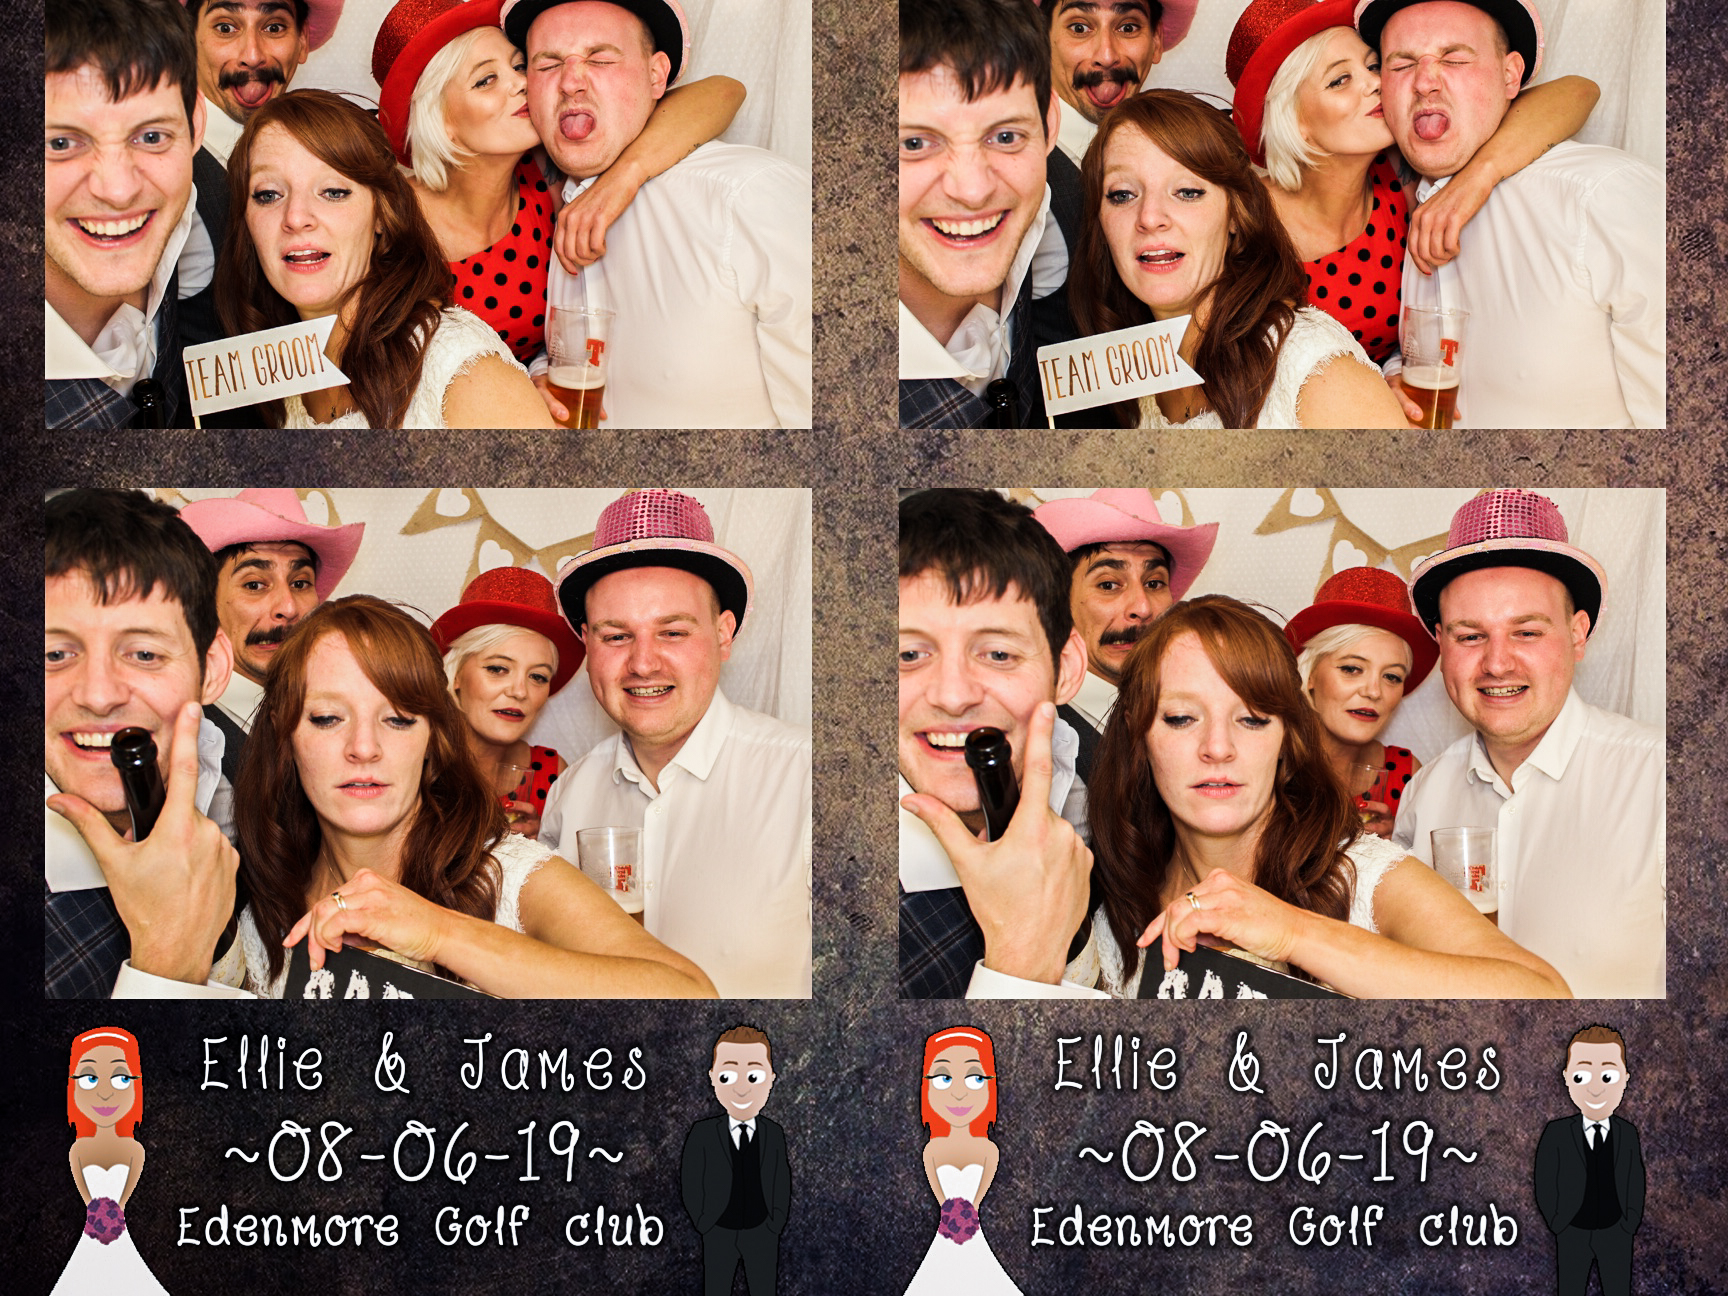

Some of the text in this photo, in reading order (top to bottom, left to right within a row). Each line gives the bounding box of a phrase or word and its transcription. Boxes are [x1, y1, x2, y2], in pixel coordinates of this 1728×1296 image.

[185, 332, 325, 401] TEAM GROOM
[586, 337, 605, 367] T
[1039, 332, 1179, 401] TEAM GROOM
[1440, 337, 1459, 367] T
